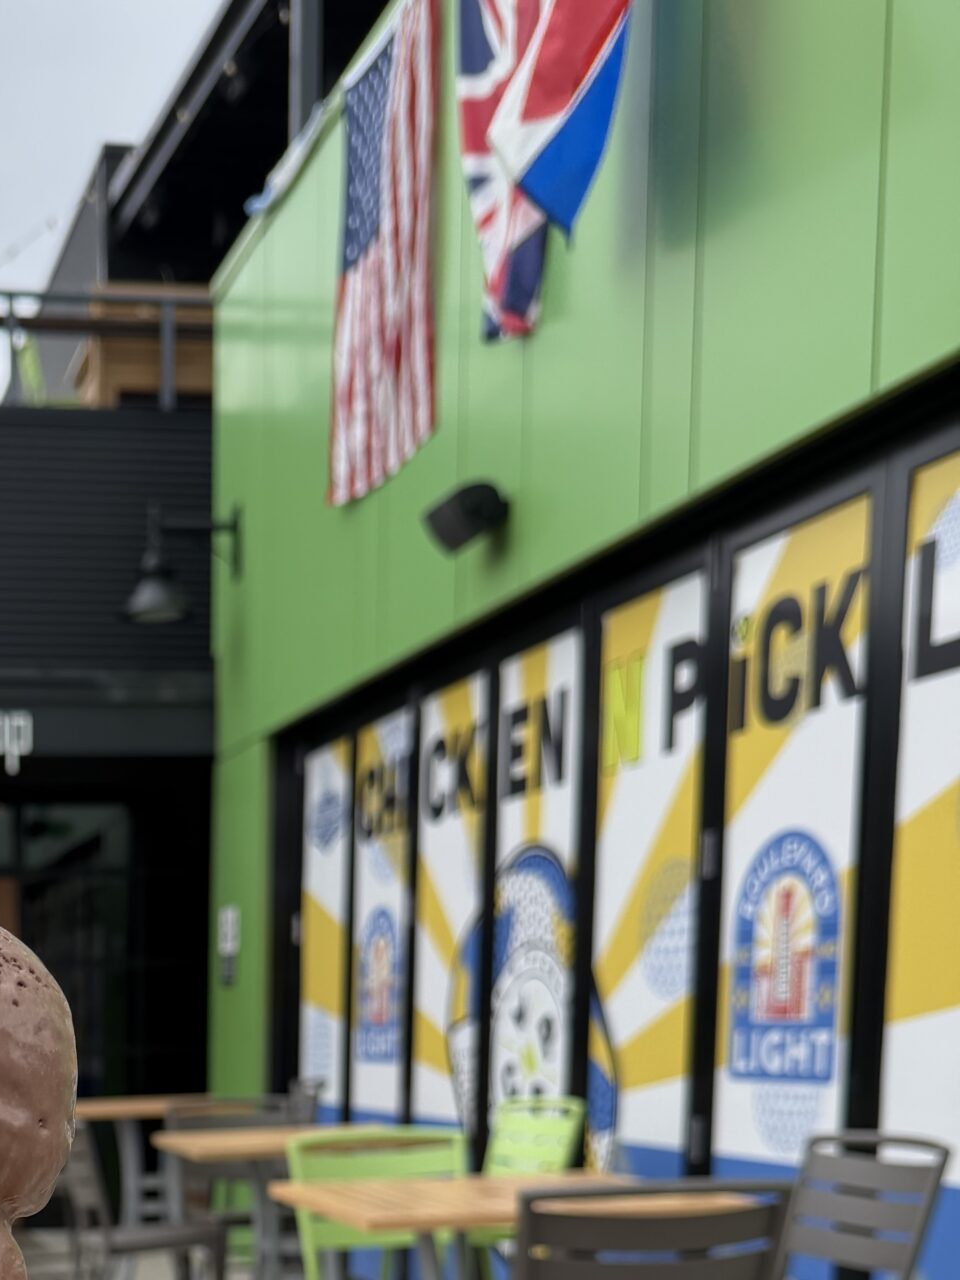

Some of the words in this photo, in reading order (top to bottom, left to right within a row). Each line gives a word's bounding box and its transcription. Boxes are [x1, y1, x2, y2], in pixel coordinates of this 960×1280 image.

[352, 684, 569, 838] CHCKEN
[602, 653, 645, 775] N
[732, 1027, 832, 1077] LIGHT
